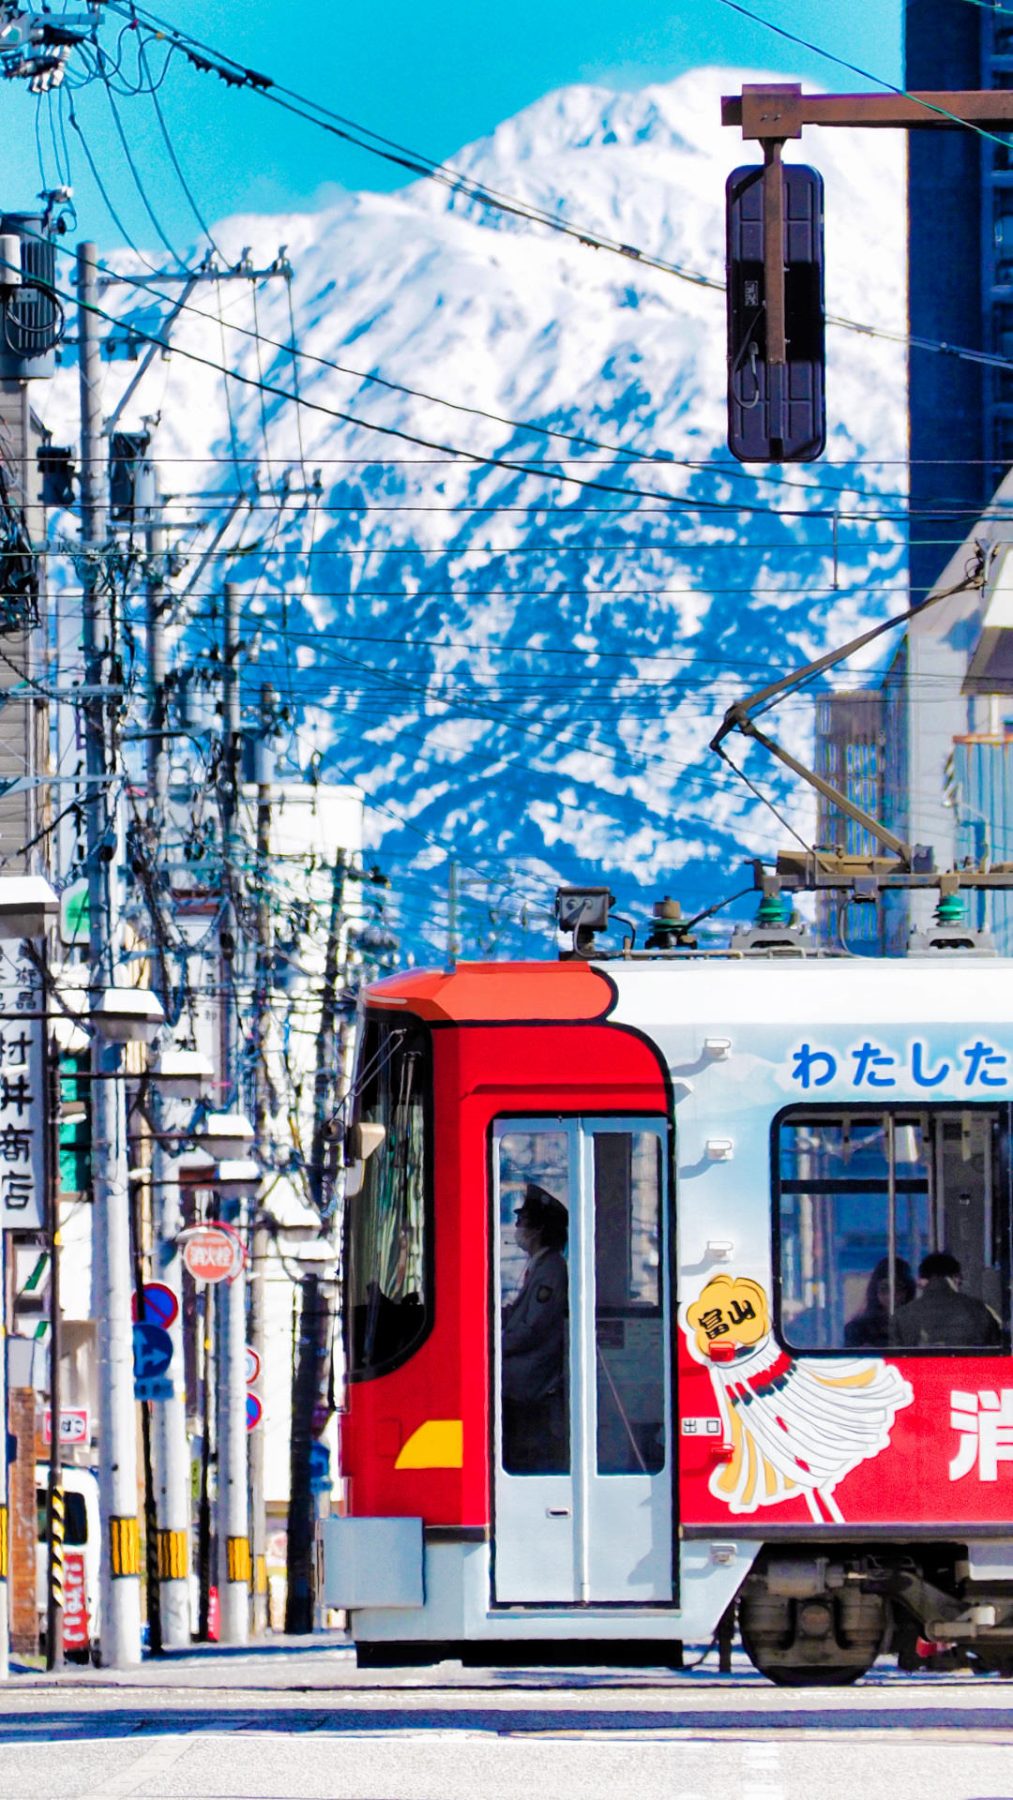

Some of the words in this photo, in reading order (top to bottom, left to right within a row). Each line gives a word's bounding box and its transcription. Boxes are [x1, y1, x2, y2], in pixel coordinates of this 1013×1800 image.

[792, 1042, 1009, 1088] わたした
[0, 1031, 34, 1210] 村井商店
[191, 1246, 230, 1266] 消火栓
[697, 1299, 757, 1340] 富山
[683, 1419, 720, 1434] 出口
[949, 1388, 1013, 1481] 消
